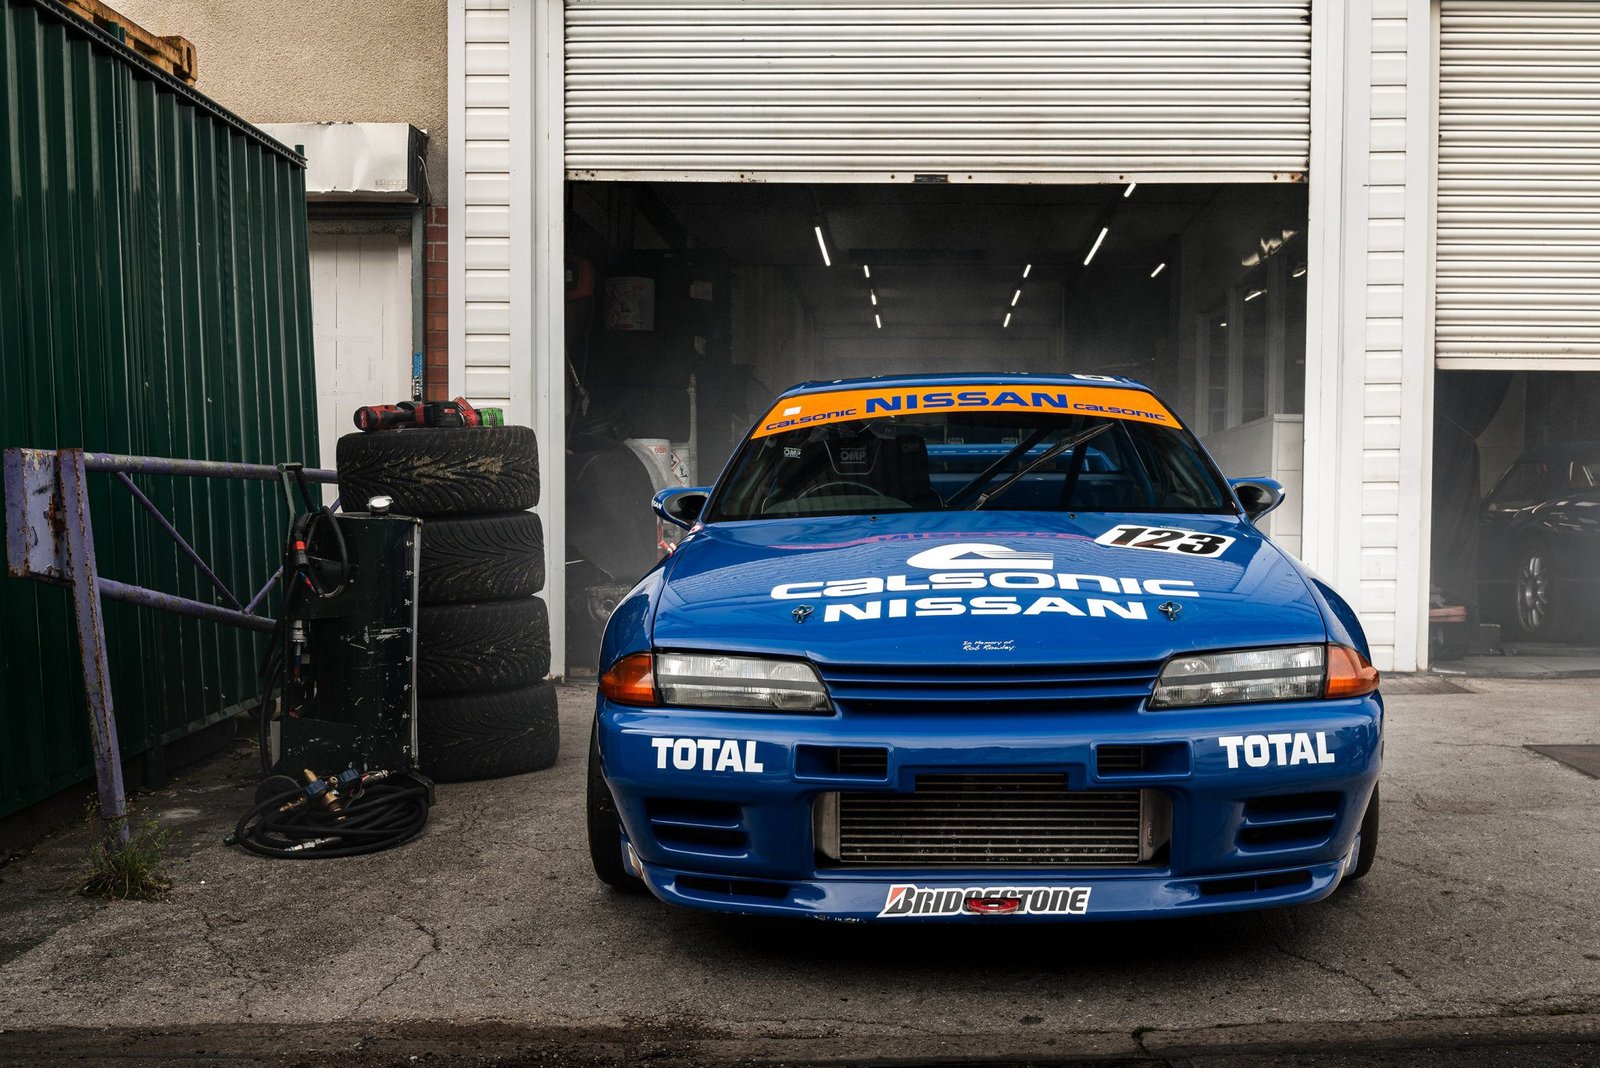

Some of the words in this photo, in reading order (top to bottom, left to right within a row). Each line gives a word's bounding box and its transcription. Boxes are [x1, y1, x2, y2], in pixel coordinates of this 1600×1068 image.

[865, 391, 1069, 413] NISSAN
[783, 448, 801, 457] OMP
[840, 451, 866, 461] OMP
[1110, 527, 1226, 554] 123
[823, 596, 1149, 622] NISSAN
[651, 737, 764, 773] TOTAL
[1218, 731, 1335, 769] TOTAL
